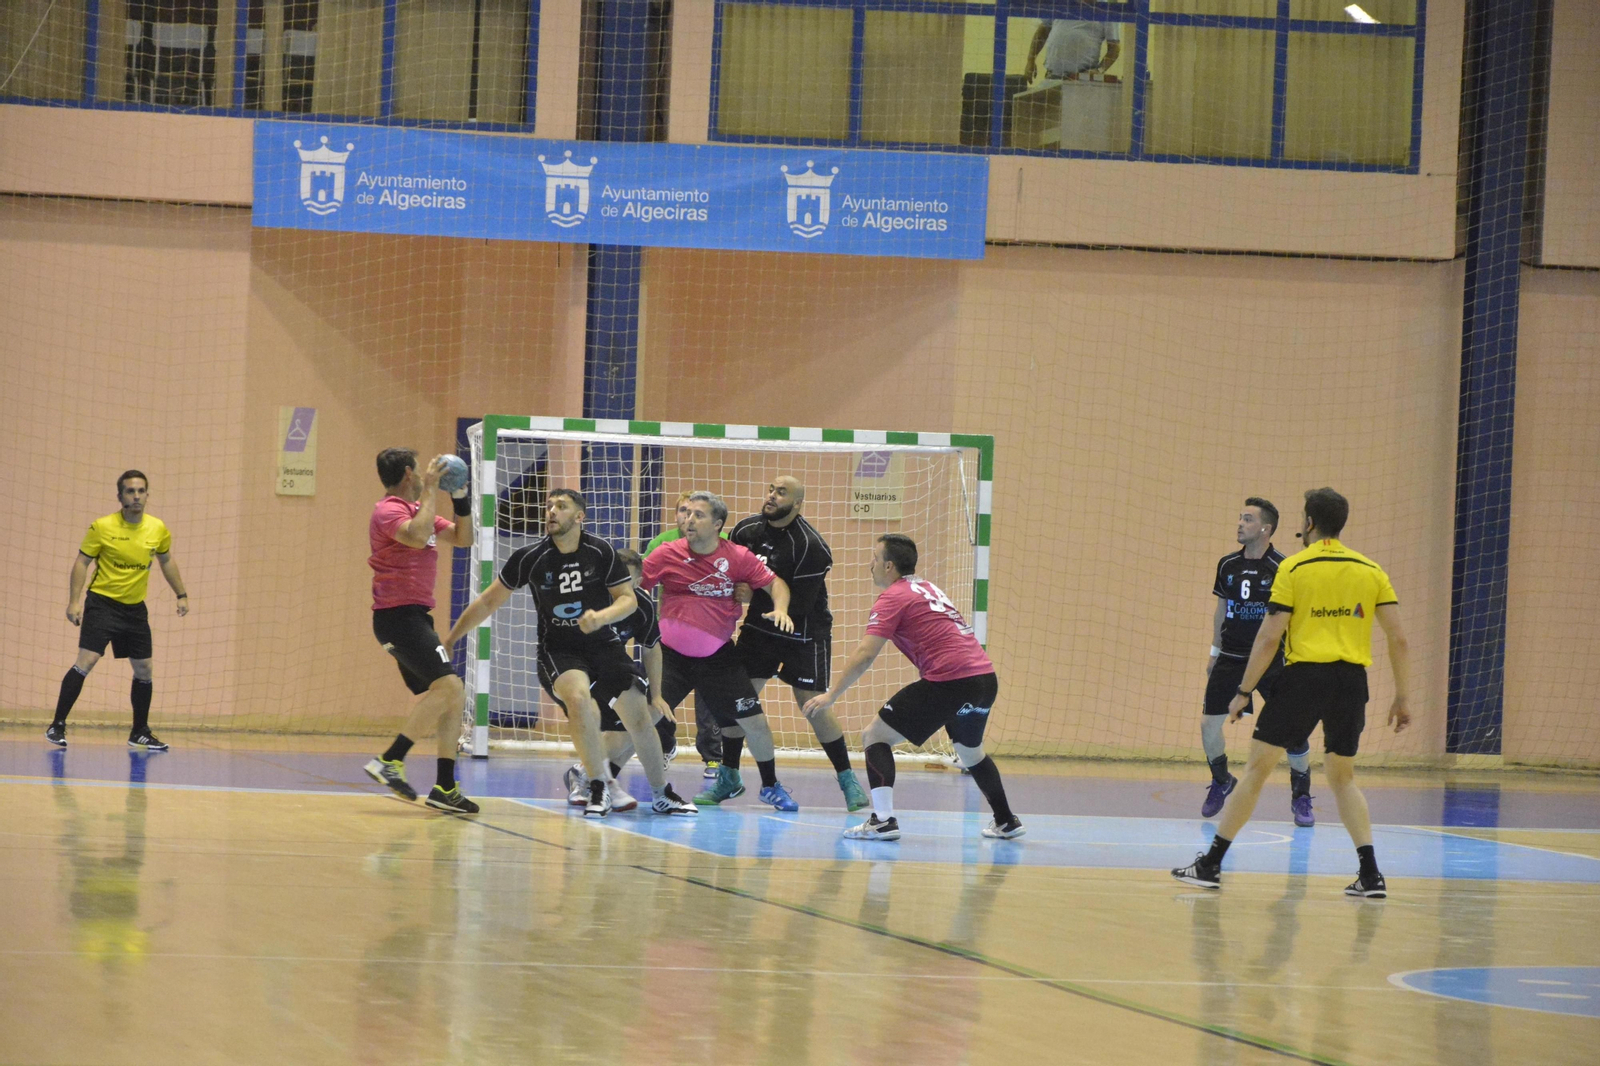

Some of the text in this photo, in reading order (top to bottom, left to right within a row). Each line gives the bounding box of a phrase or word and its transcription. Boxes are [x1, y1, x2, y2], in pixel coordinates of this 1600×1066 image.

[356, 171, 467, 191] Ayuntamiento
[356, 189, 466, 211] de Algeciras
[601, 185, 709, 203] Ayuntamiento
[841, 194, 949, 213] Ayuntamiento
[601, 202, 708, 222] de Algeciras
[841, 212, 948, 233] de Algeciras
[854, 491, 897, 502] Vestuarios
[853, 504, 871, 513] C-D
[558, 570, 584, 594] 22
[1240, 579, 1251, 600] 6
[1310, 605, 1351, 618] helvetia
